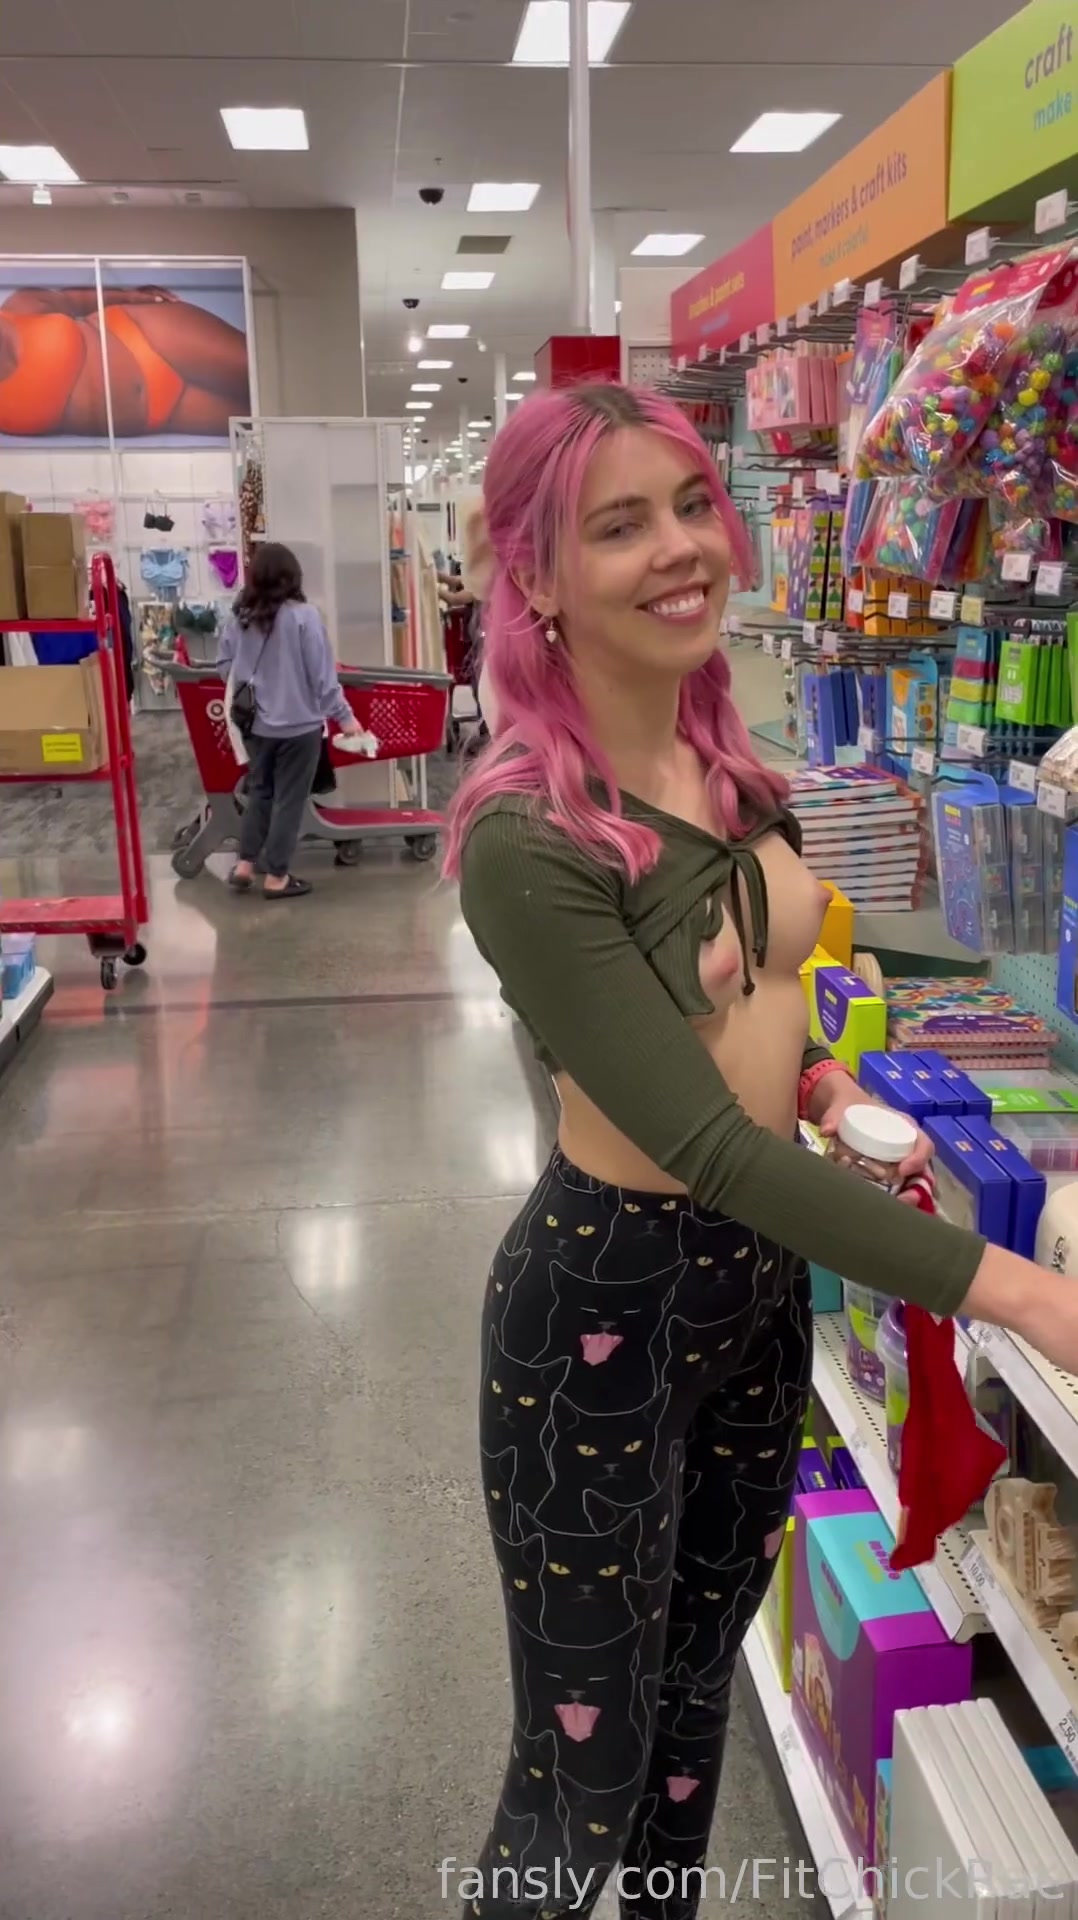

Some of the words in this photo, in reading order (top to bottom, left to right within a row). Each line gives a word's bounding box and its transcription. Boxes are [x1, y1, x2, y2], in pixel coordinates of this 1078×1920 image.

[1024, 22, 1072, 89] craft
[1034, 89, 1072, 131] make
[860, 162, 885, 208] craft
[886, 150, 907, 187] kits
[968, 1562, 986, 1587] 10.00
[1058, 1717, 1076, 1743] 2.50
